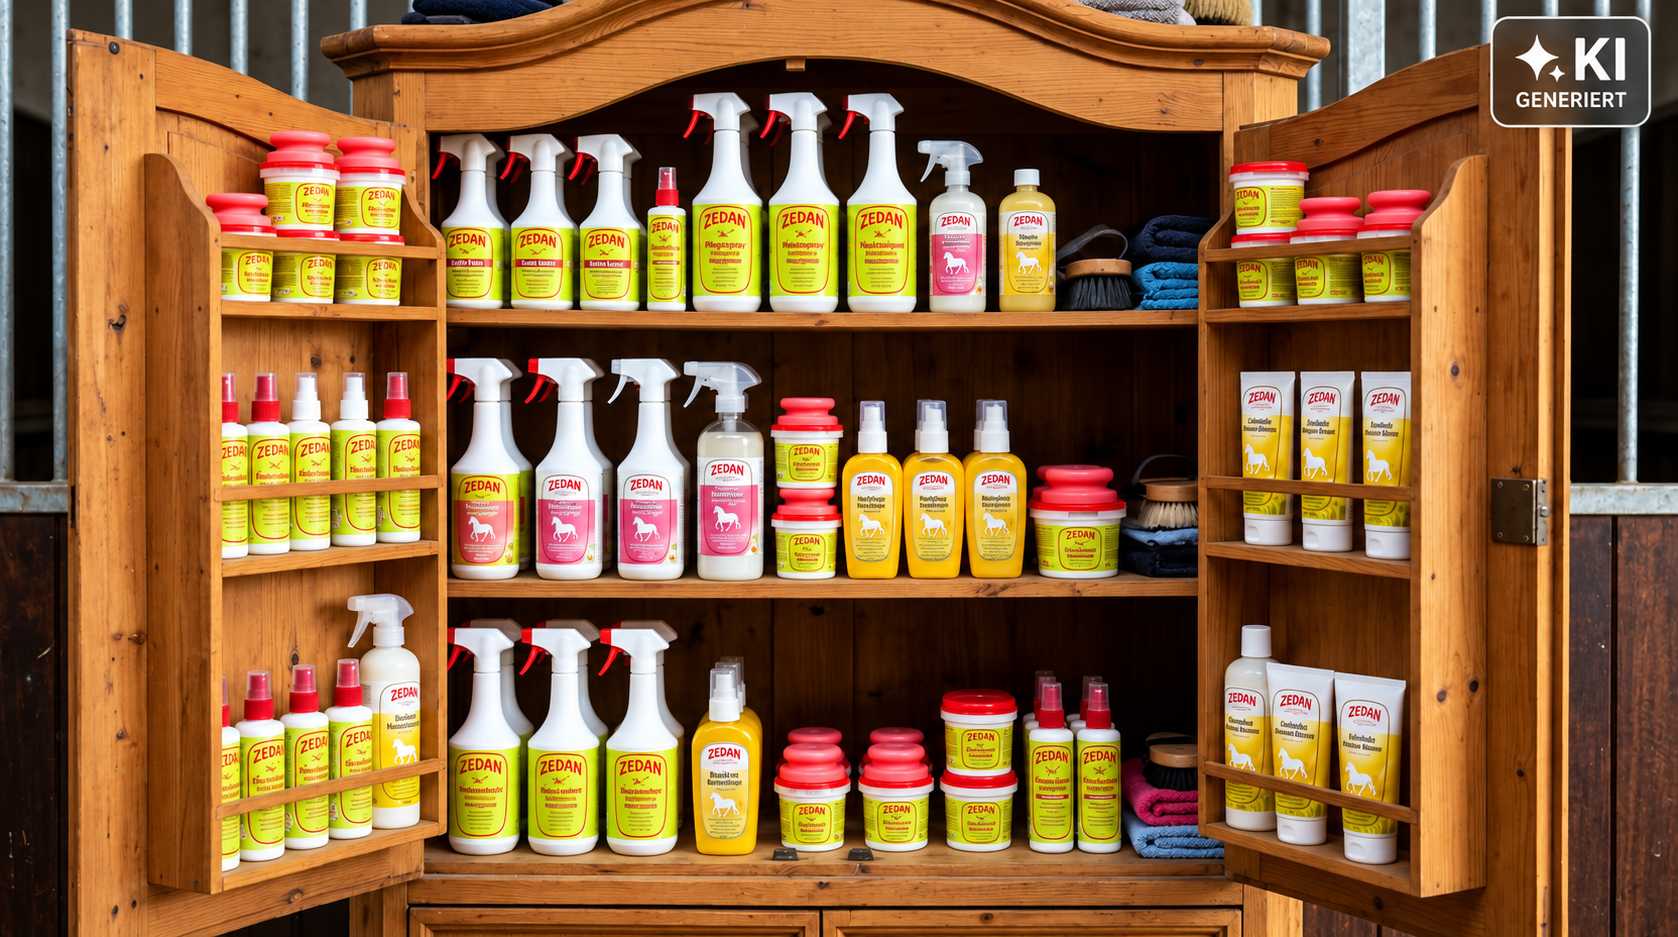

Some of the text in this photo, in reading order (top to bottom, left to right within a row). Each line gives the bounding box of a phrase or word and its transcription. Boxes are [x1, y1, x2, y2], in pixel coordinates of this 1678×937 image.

[368, 190, 395, 200] ZEDAN
[704, 212, 745, 229] ZEDAN
[782, 212, 824, 229] ZEDAN
[860, 212, 902, 229] ZEDAN
[941, 216, 970, 227] ZEDAN
[1014, 216, 1042, 227] ZEDAN
[652, 221, 678, 234] ZEDAN
[449, 233, 486, 248] ZEDAN
[520, 233, 556, 248] ZEDAN
[589, 234, 624, 248] ZEDAN
[1248, 392, 1276, 404] ZEDAN
[1308, 392, 1336, 404] ZEDAN
[1370, 393, 1400, 406] ZEDAN
[794, 447, 819, 456] ZEDAN
[711, 464, 744, 476] ZEDAN
[548, 479, 581, 491] ZEDAN
[630, 479, 663, 491] ZEDAN
[857, 476, 885, 485] ZEDAN
[919, 475, 948, 485] ZEDAN
[981, 475, 1010, 485] ZEDAN
[464, 480, 500, 494] ZEDAN
[794, 537, 819, 545] ZEDAN
[1066, 531, 1095, 540] ZEDAN
[391, 687, 418, 702] ZEDAN
[1228, 692, 1256, 706] ZEDAN
[1280, 695, 1312, 710] ZEDAN
[1349, 706, 1381, 722] ZEDAN
[967, 733, 994, 741] ZEDAN
[708, 747, 740, 760] ZEDAN
[1035, 751, 1068, 764] ZEDAN
[1084, 751, 1116, 764] ZEDAN
[459, 758, 502, 774] ZEDAN
[540, 759, 582, 776] ZEDAN
[619, 760, 661, 776] ZEDAN
[799, 806, 825, 815] ZEDAN
[883, 805, 910, 814] ZEDAN
[968, 806, 995, 814] ZEDAN
